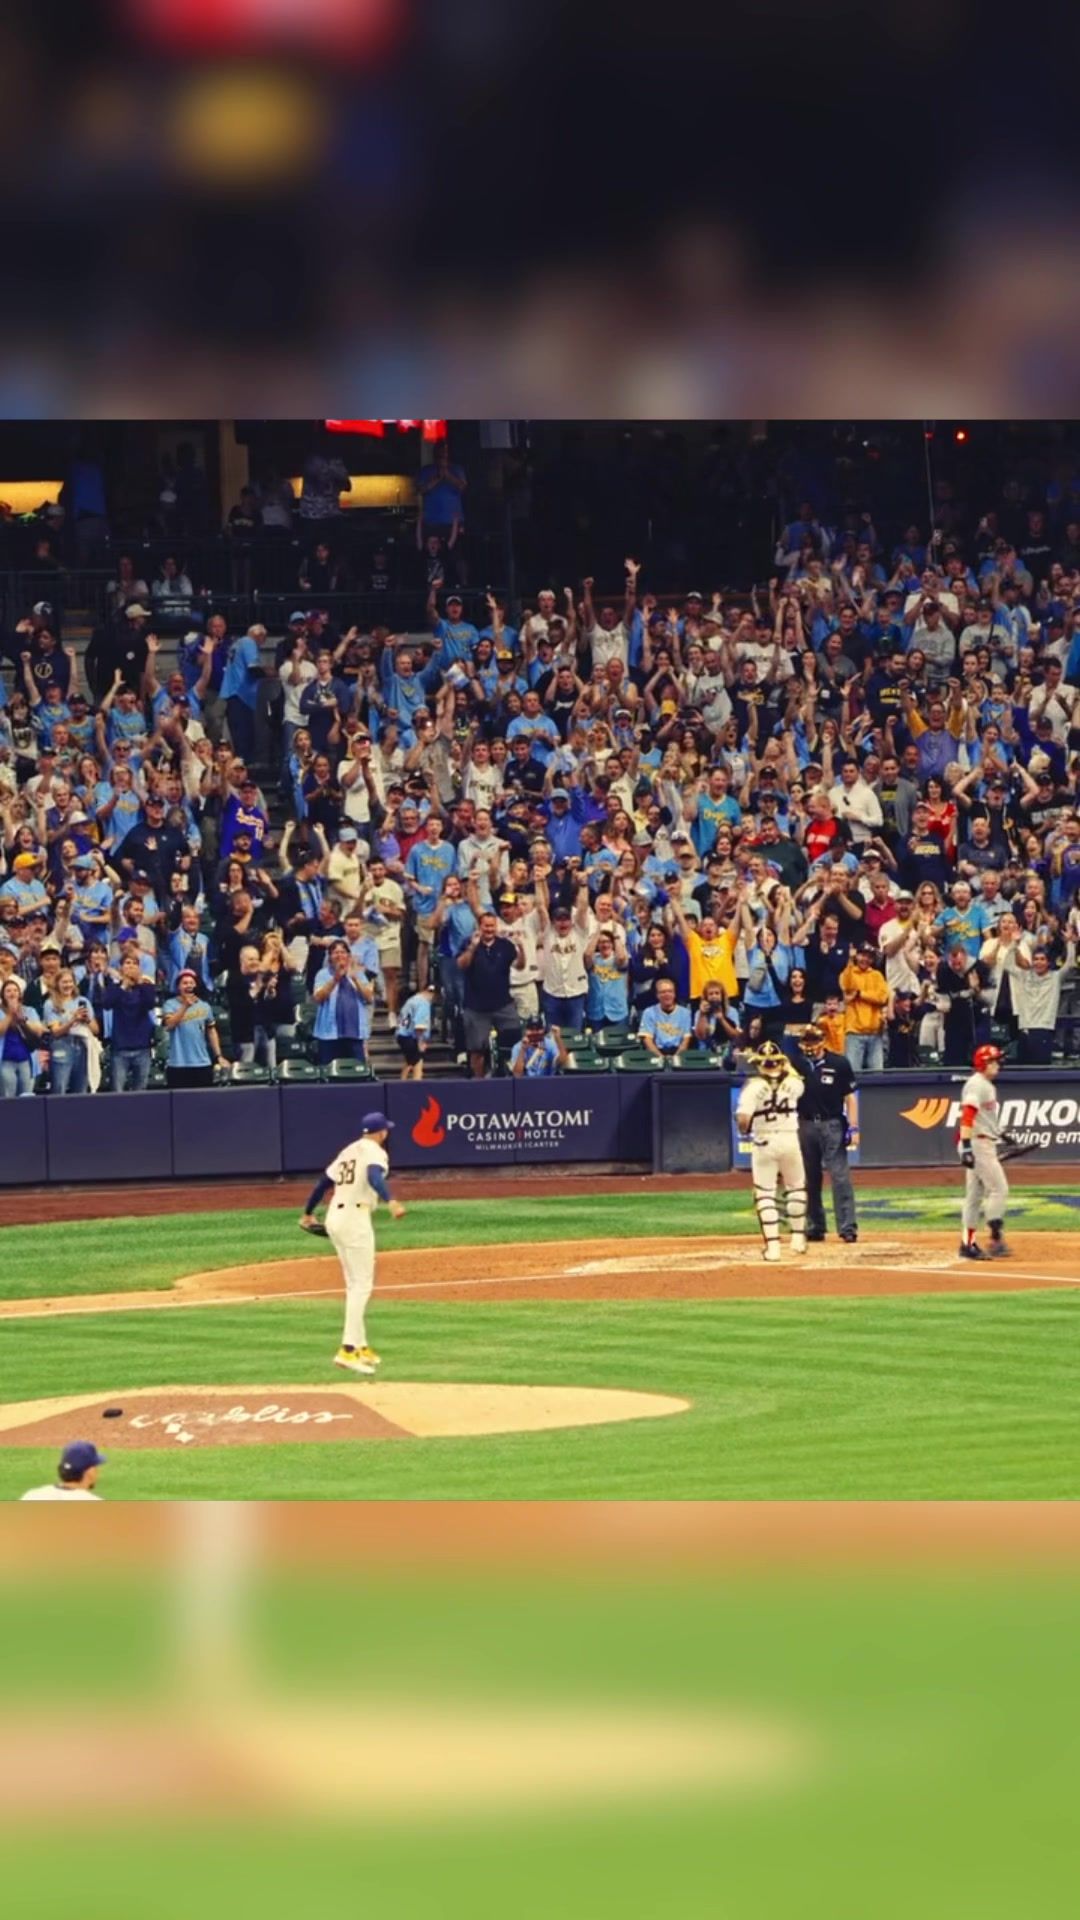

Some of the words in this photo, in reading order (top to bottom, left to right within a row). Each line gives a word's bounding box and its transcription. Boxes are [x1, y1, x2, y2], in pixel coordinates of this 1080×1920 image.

[446, 1109, 590, 1131] POTAWATOMI
[763, 1096, 790, 1122] 24
[467, 1131, 516, 1142] CASINO
[524, 1128, 566, 1140] HOTEL
[337, 1159, 357, 1186] 38
